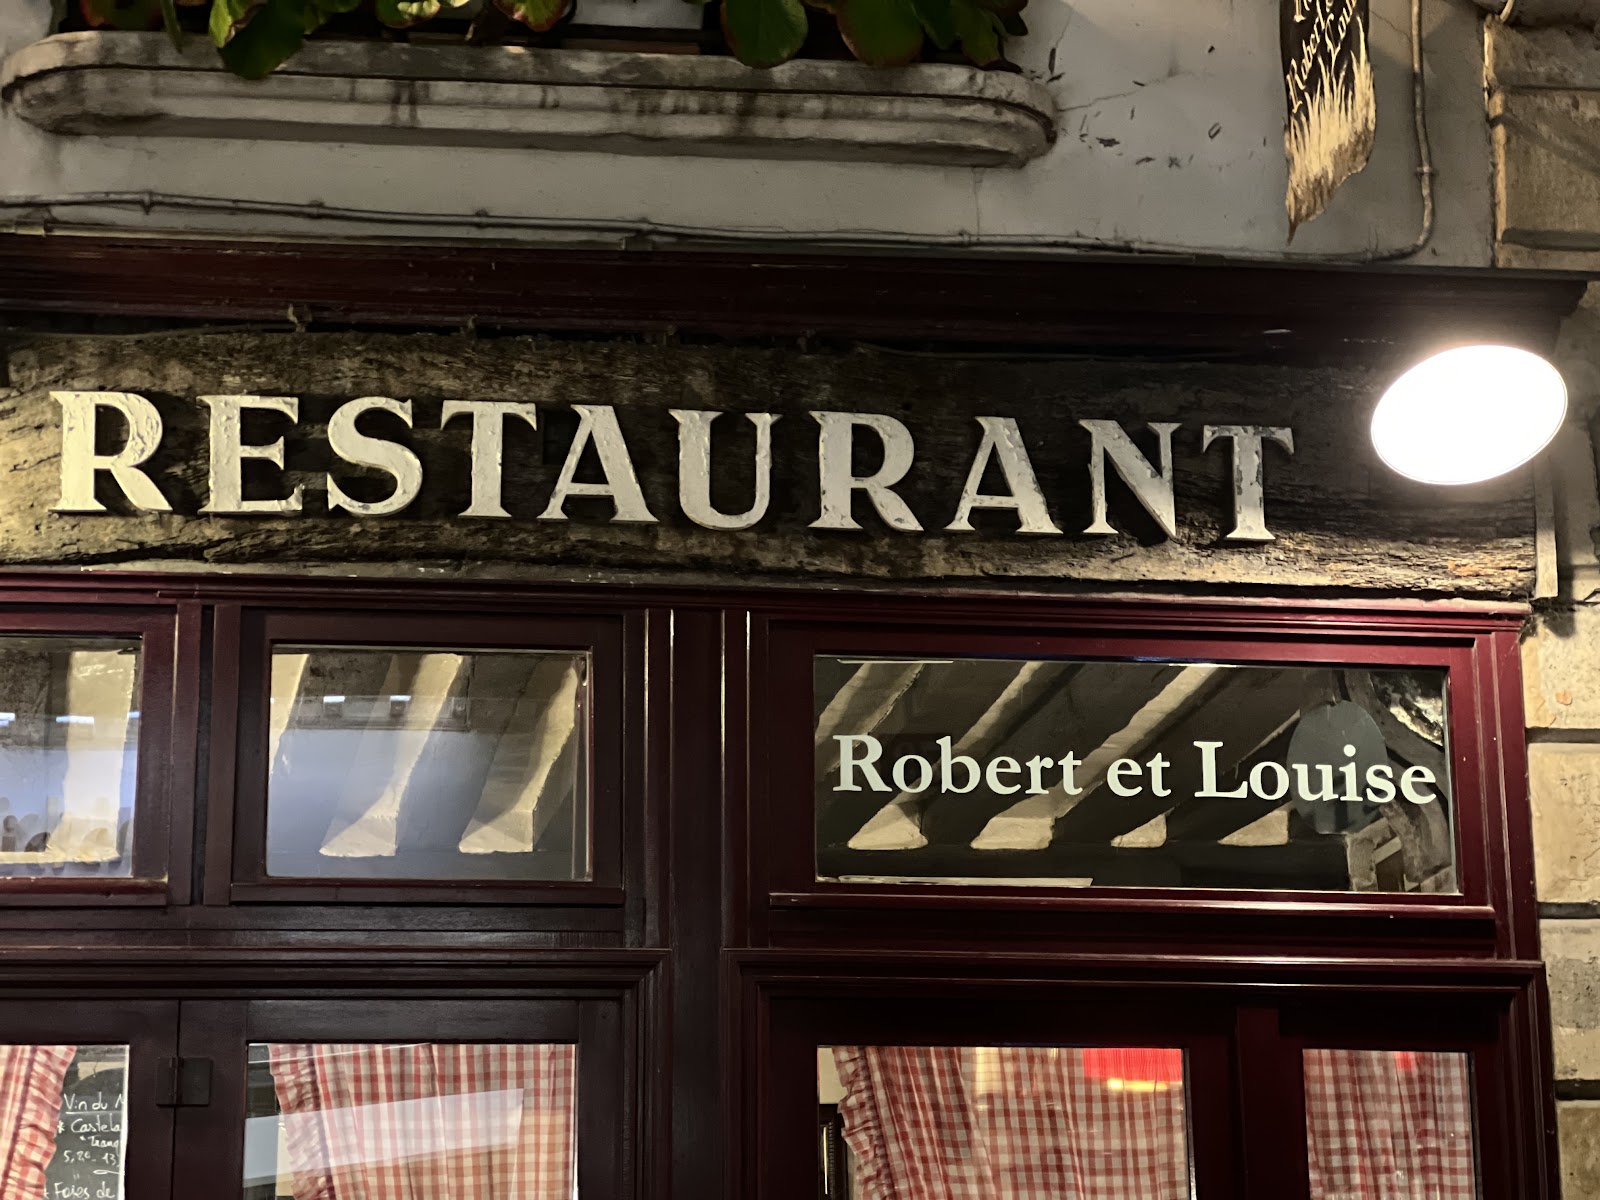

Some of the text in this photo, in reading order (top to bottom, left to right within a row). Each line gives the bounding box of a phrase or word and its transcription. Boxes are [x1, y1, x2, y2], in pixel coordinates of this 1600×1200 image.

[48, 390, 1295, 541] RESTAURANT
[832, 734, 1438, 806] Robert et Louise
[63, 1092, 88, 1110] Vin
[91, 1091, 108, 1110] du
